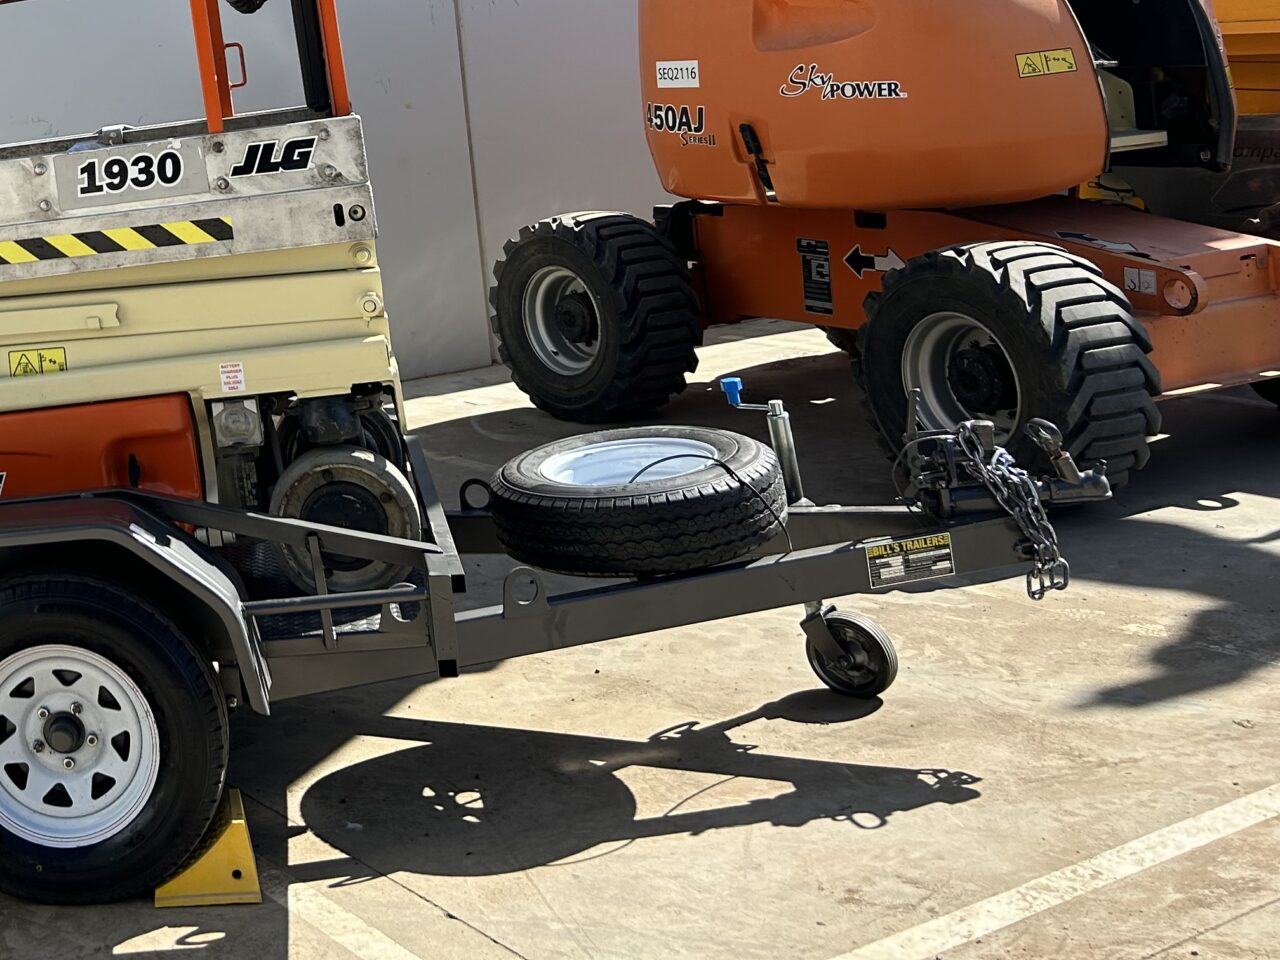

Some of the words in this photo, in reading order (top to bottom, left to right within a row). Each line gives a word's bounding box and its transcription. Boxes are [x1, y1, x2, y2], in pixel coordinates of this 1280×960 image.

[658, 67, 696, 81] SEQ2116
[647, 102, 705, 134] 450AJ
[230, 136, 318, 178] JLG
[78, 150, 184, 197] 1930
[873, 542, 900, 556] BILL'S
[901, 536, 945, 551] TRAILERS
